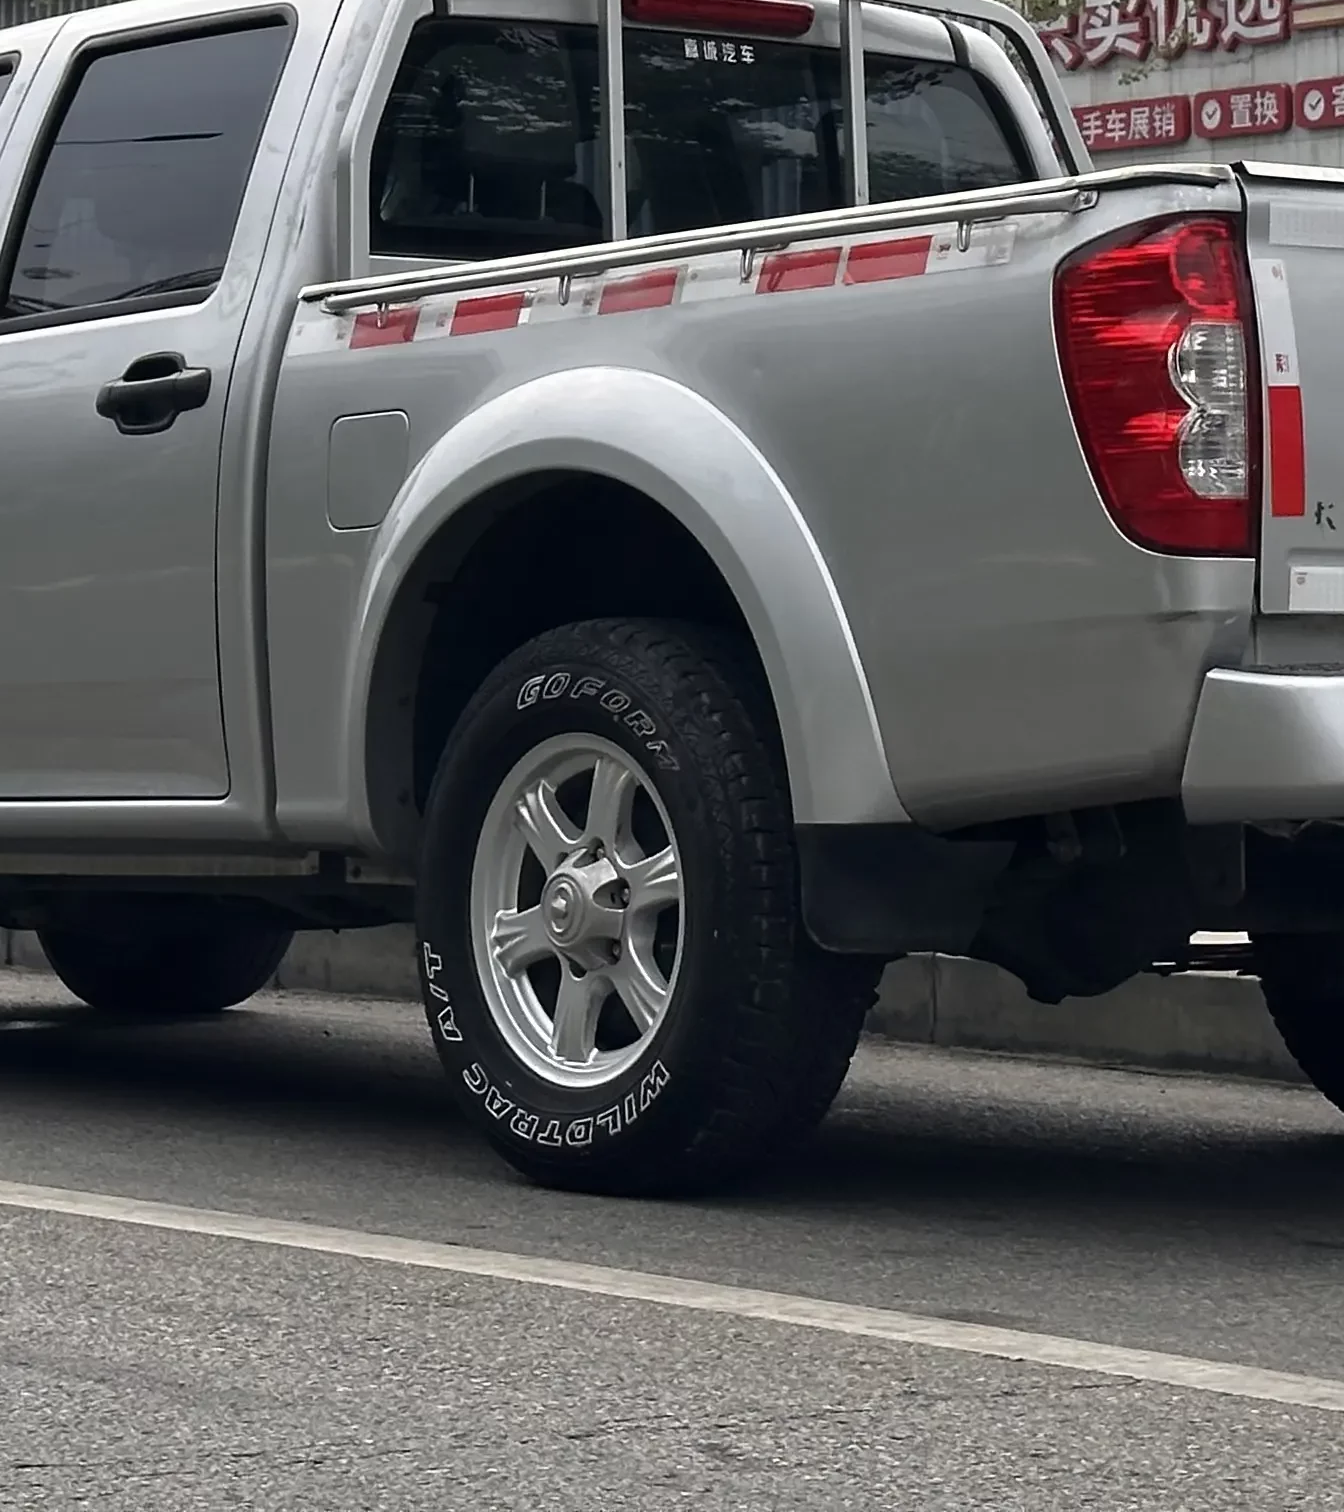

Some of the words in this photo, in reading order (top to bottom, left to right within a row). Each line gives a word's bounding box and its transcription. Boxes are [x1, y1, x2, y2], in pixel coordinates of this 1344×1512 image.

[1075, 101, 1175, 147] 手车展销
[1229, 90, 1279, 129] 置换
[517, 672, 681, 771] GOFORM
[423, 941, 464, 1042] A/T
[462, 1059, 671, 1147] WILDTRAC
